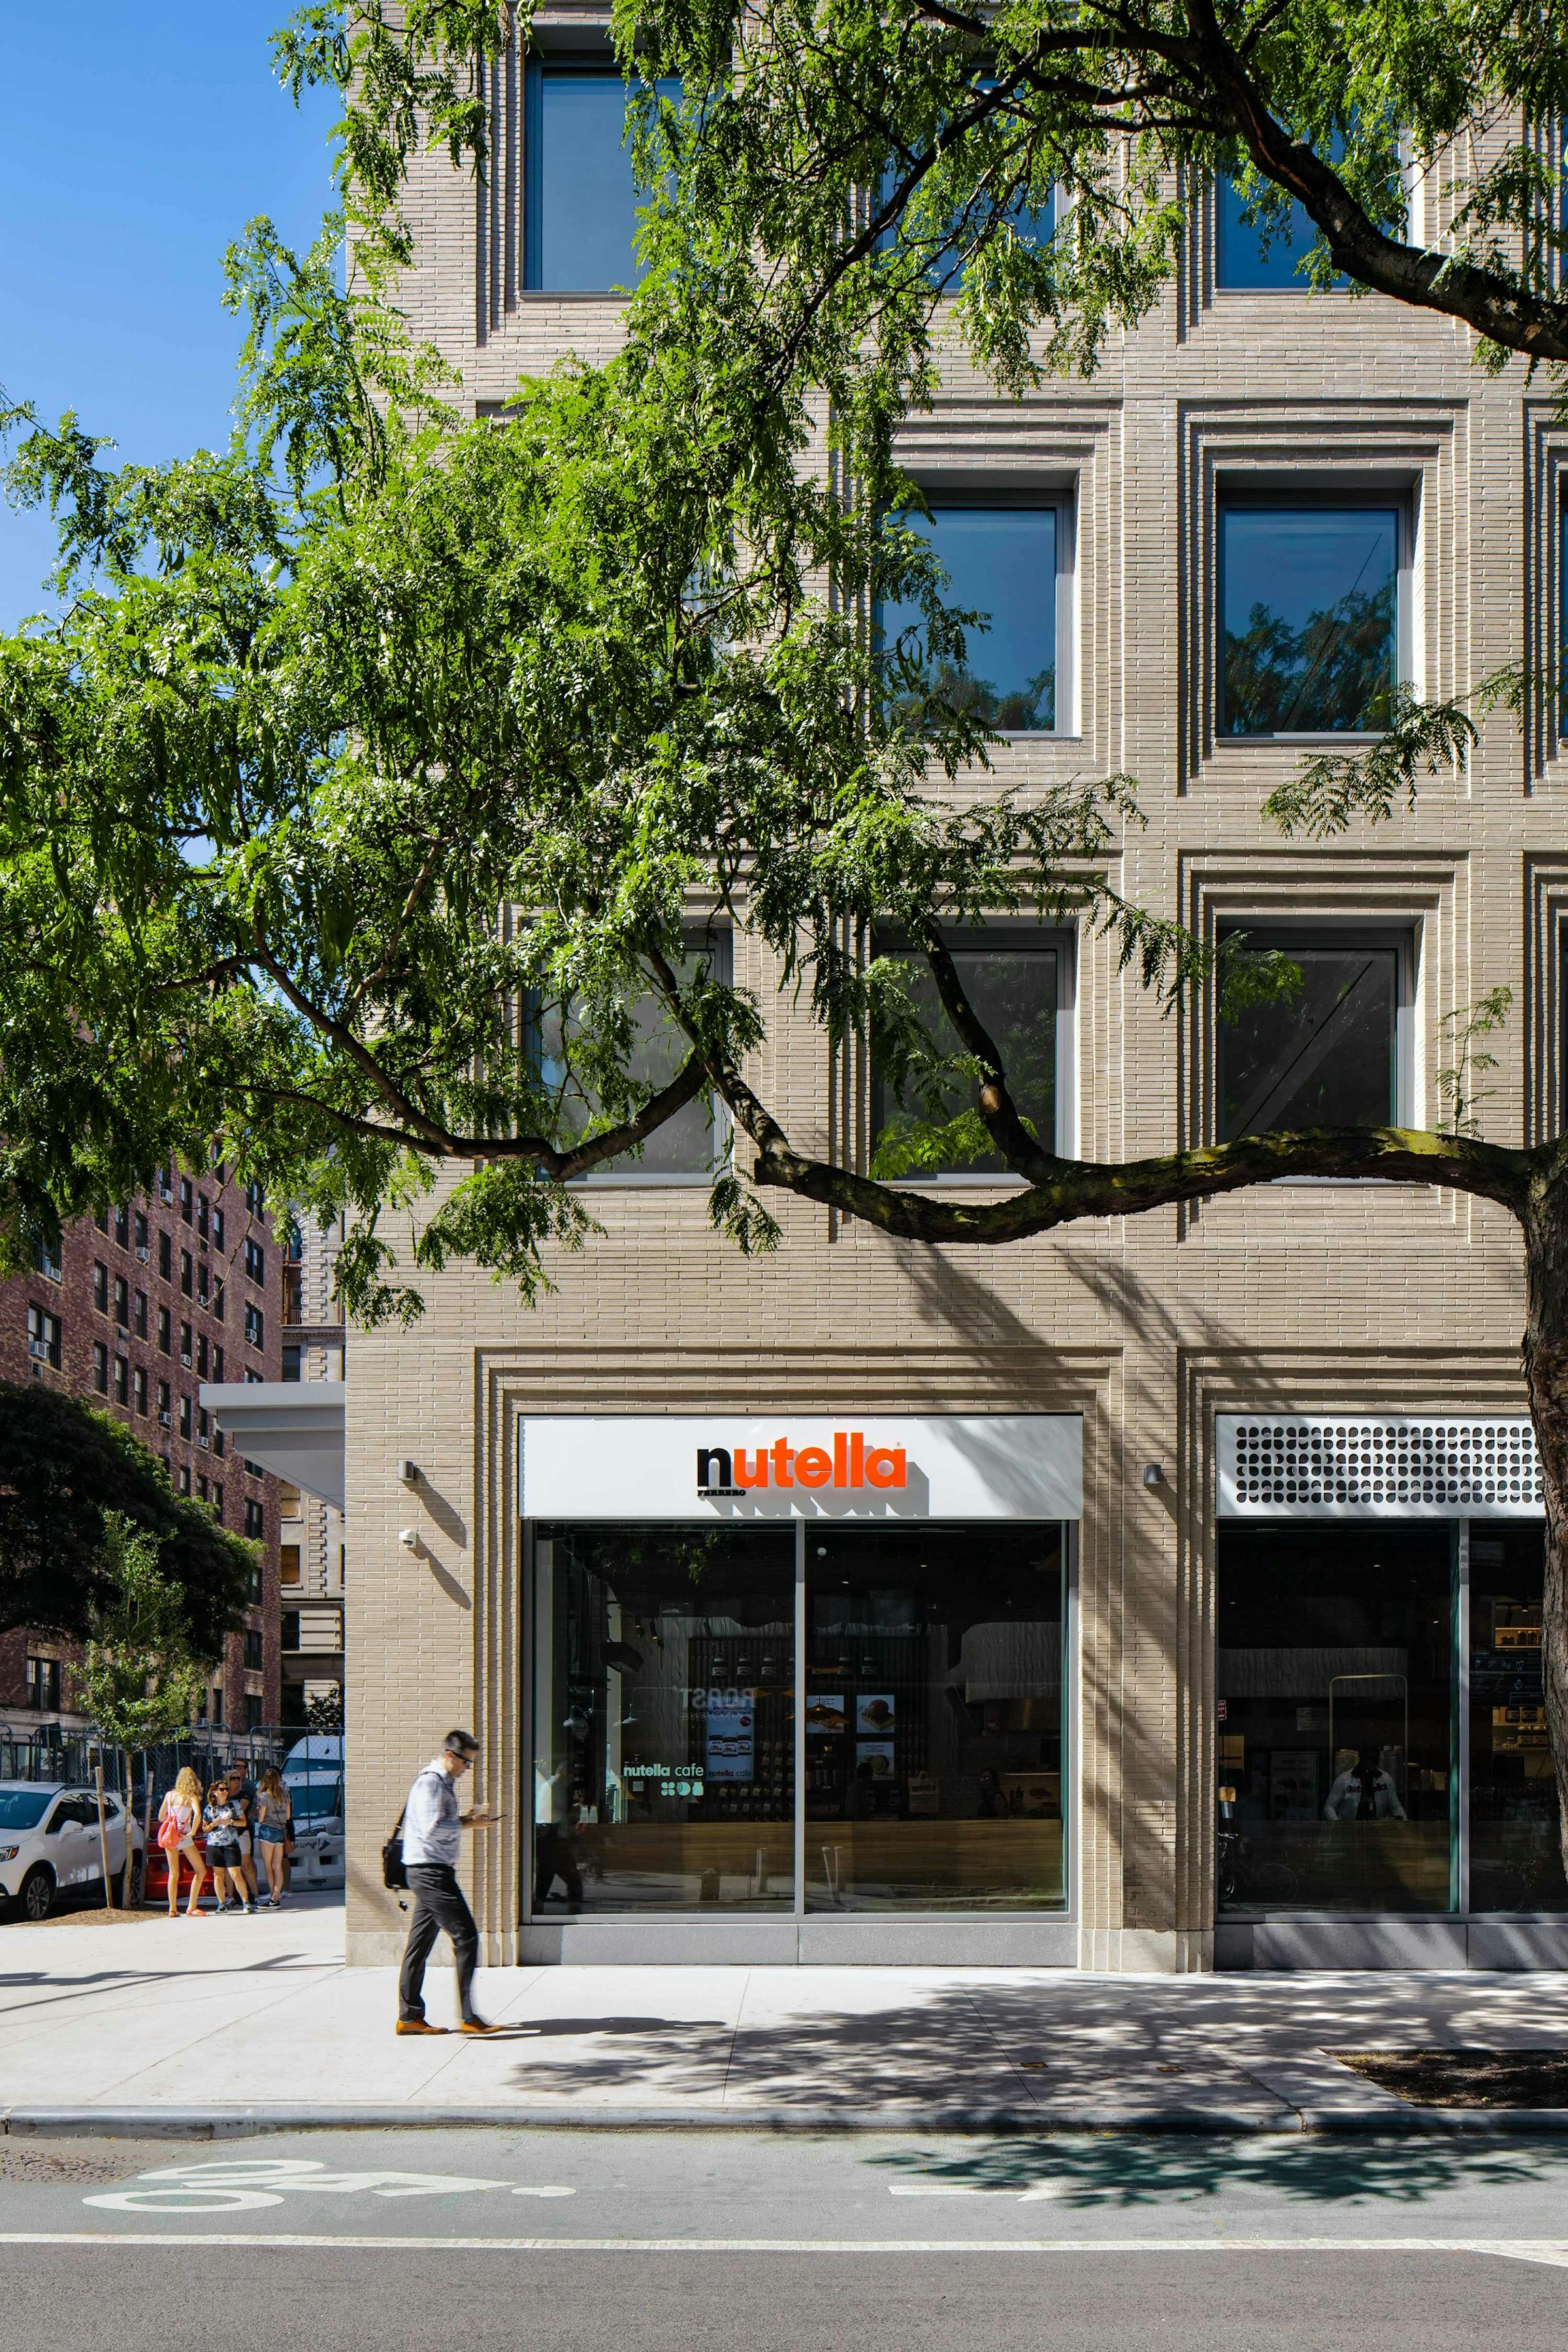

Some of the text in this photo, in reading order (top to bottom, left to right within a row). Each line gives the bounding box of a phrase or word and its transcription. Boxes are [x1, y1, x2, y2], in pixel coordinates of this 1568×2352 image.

[697, 1432, 906, 1488] nutella
[623, 1763, 704, 1776] nutella cafe
